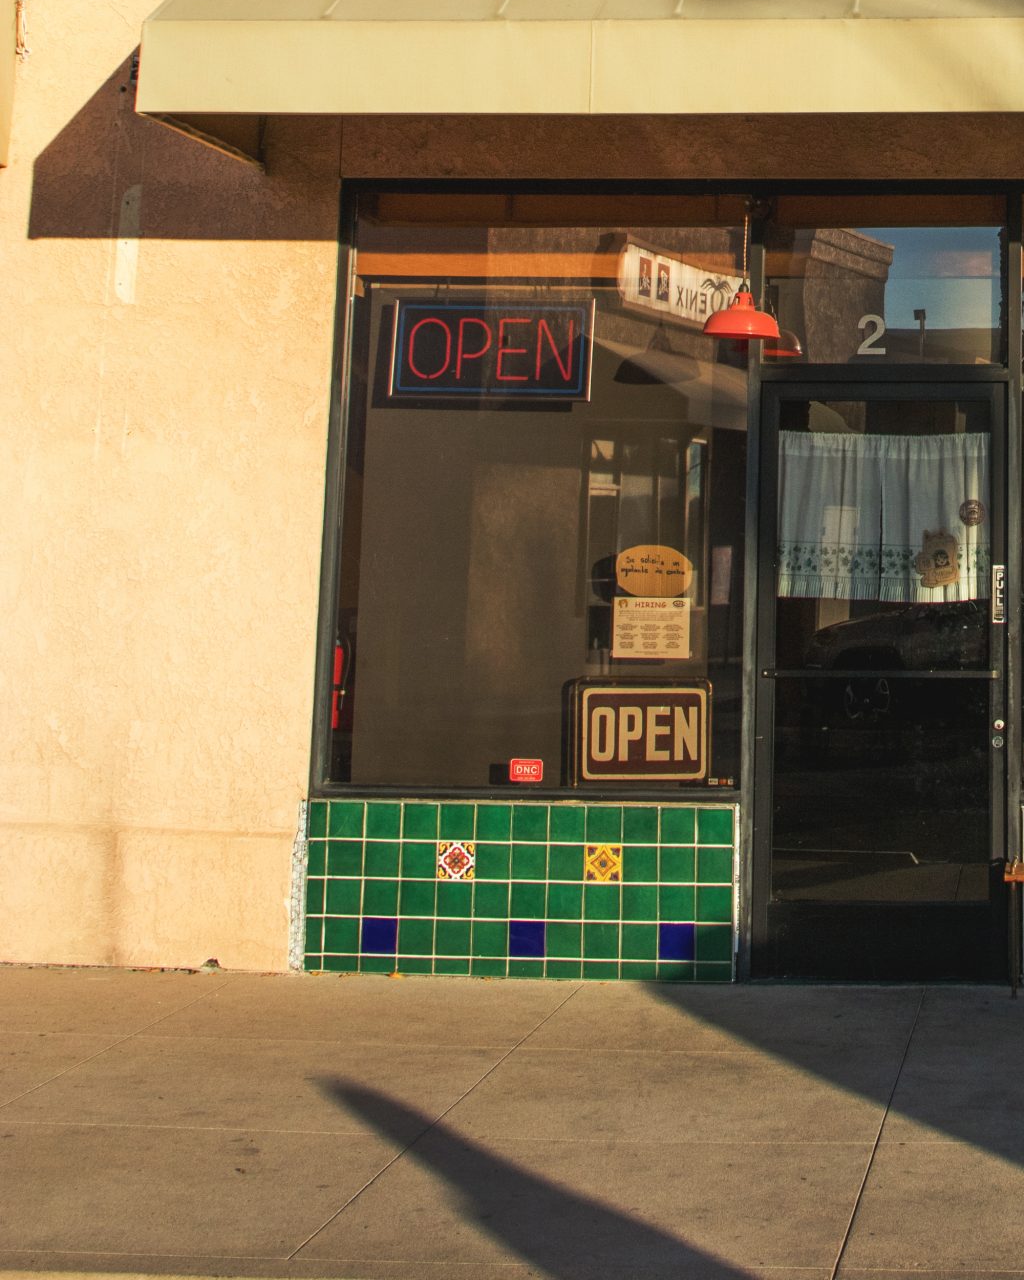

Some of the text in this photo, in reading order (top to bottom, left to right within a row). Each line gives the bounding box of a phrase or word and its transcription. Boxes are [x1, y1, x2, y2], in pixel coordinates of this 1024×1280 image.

[407, 317, 577, 382] OPEN
[857, 315, 886, 356] 2
[996, 571, 1004, 606] PULL
[590, 704, 699, 762] OPEN
[516, 766, 537, 774] DNC
